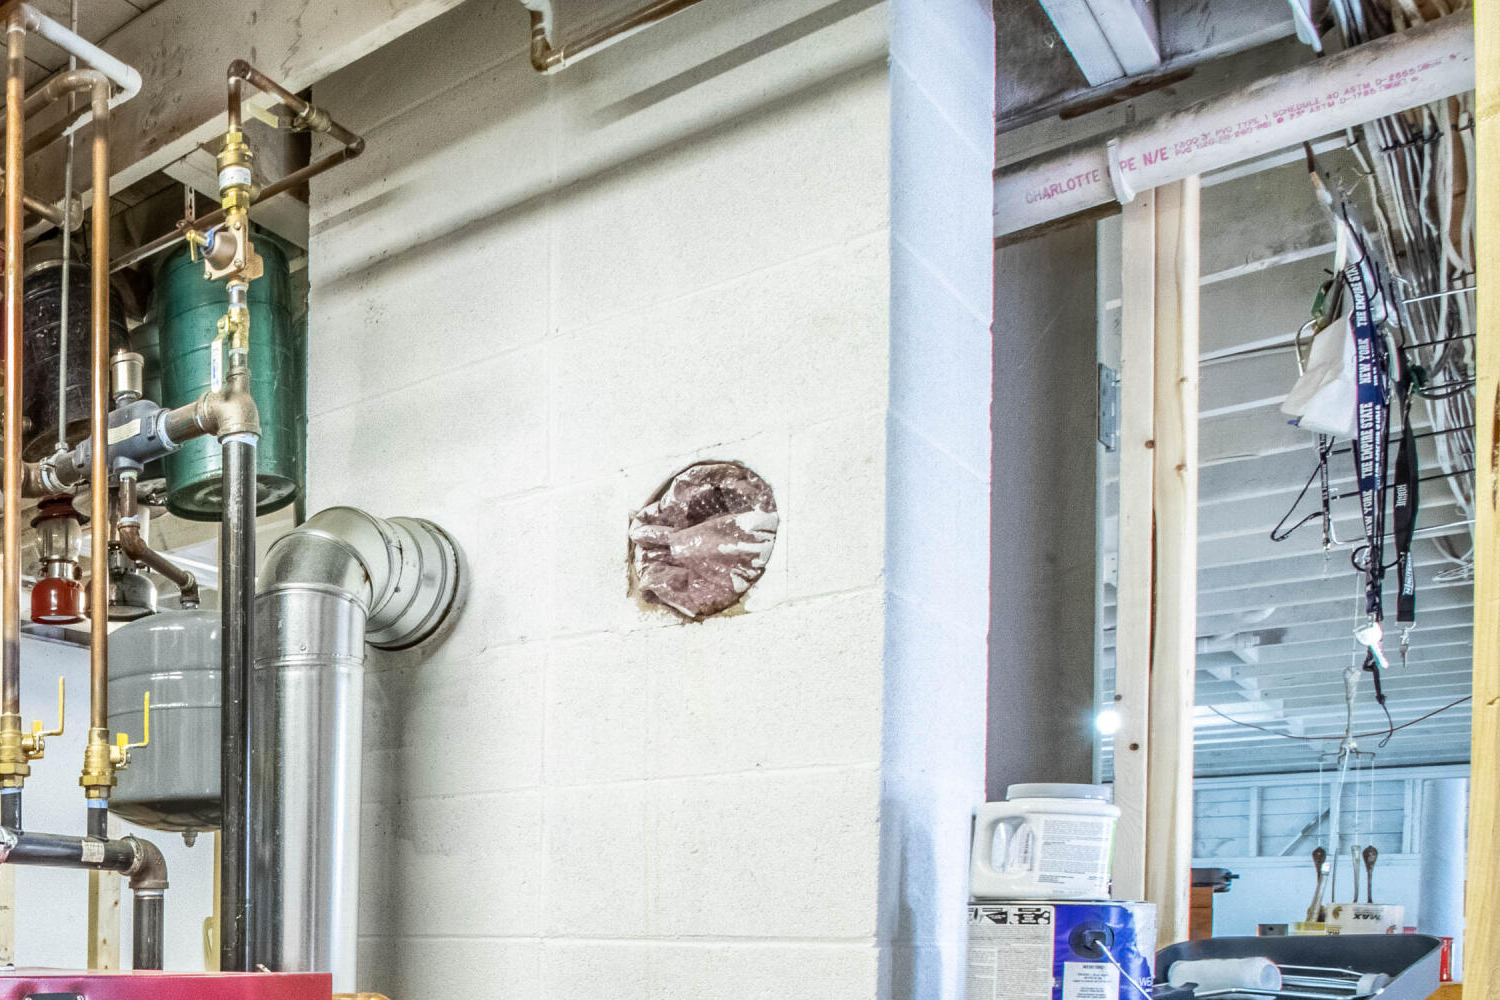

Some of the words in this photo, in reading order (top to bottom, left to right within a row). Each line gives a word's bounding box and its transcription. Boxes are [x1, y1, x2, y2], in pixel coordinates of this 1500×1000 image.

[1026, 168, 1101, 205] CHARLOTTE
[1142, 146, 1170, 166] N/E
[1272, 97, 1320, 119] SCHEDULE
[1351, 281, 1367, 311] EMPIRE
[1355, 310, 1369, 328] THE
[1357, 338, 1371, 363] YORK
[1358, 363, 1373, 385] NEW
[1359, 401, 1373, 430] STATE
[1360, 429, 1374, 462] EMPIRE
[1360, 461, 1373, 479] THE
[1362, 489, 1373, 514] YORK
